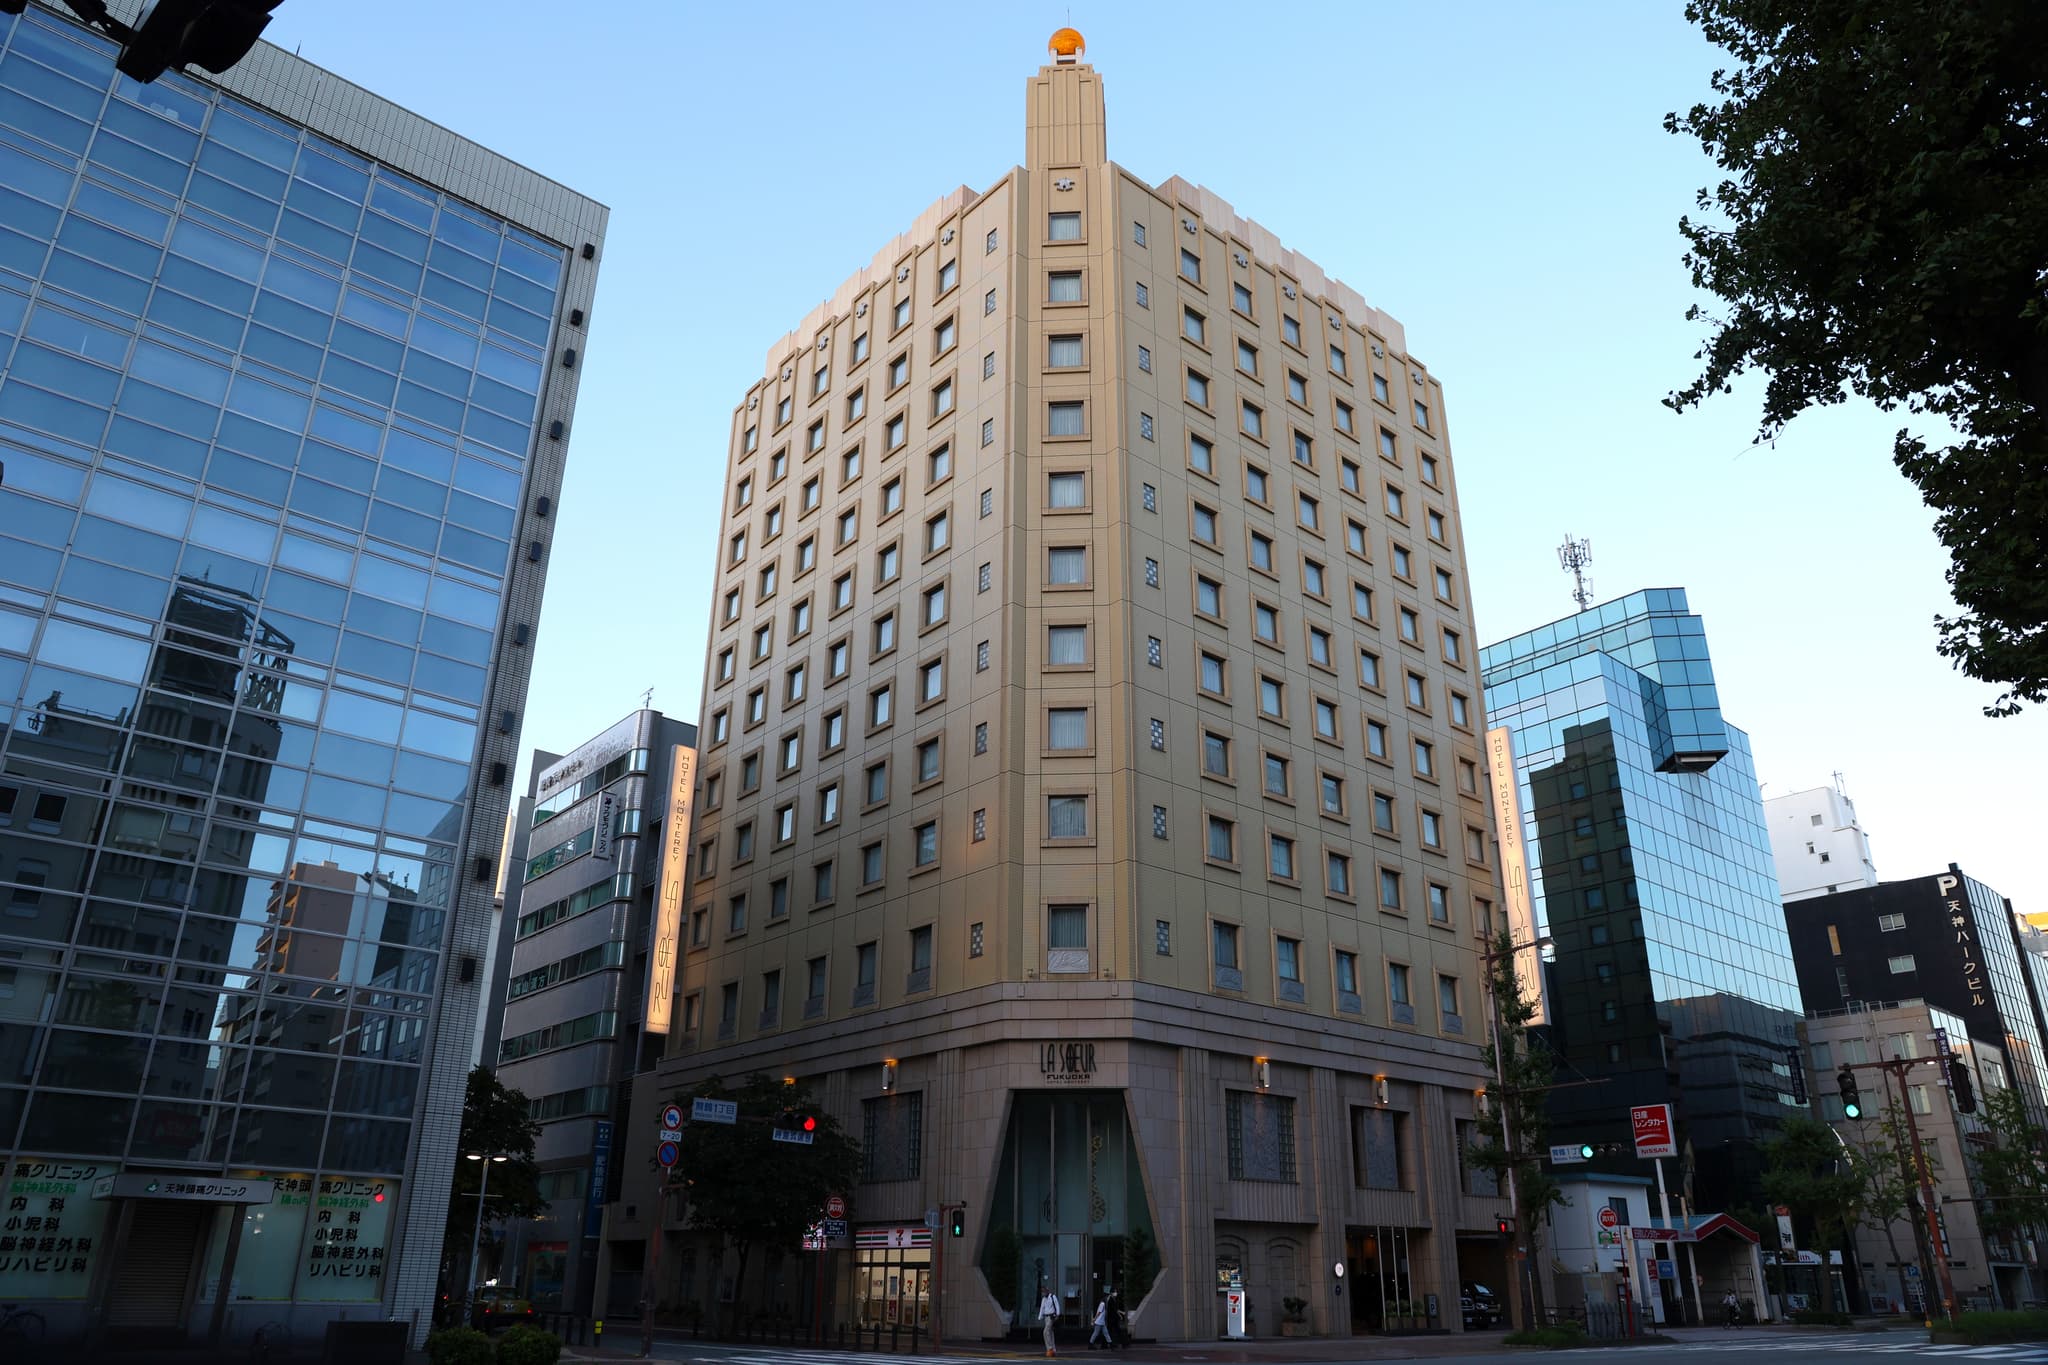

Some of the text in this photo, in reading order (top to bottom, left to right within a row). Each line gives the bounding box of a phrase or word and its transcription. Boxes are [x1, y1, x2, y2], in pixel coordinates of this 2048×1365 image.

[1496, 737, 1505, 776] HOTEL
[679, 755, 690, 793] HOTEL
[1500, 783, 1514, 847] MONTEREY
[672, 800, 686, 861] MONTEREY
[1937, 875, 1958, 897] P
[1947, 900, 1985, 1006] 天神パークビル
[1041, 1044, 1054, 1072] LA
[1633, 1111, 1648, 1119] 日産
[1635, 1119, 1665, 1128] レンタカー
[661, 1131, 681, 1141] 7-20
[165, 1183, 247, 1197] 天神頭痛クリニック
[5, 1216, 60, 1231] 小児科
[315, 1228, 358, 1241] 小児科
[311, 1246, 384, 1260] 脳神経外科
[310, 1263, 381, 1278] リハビリ科
